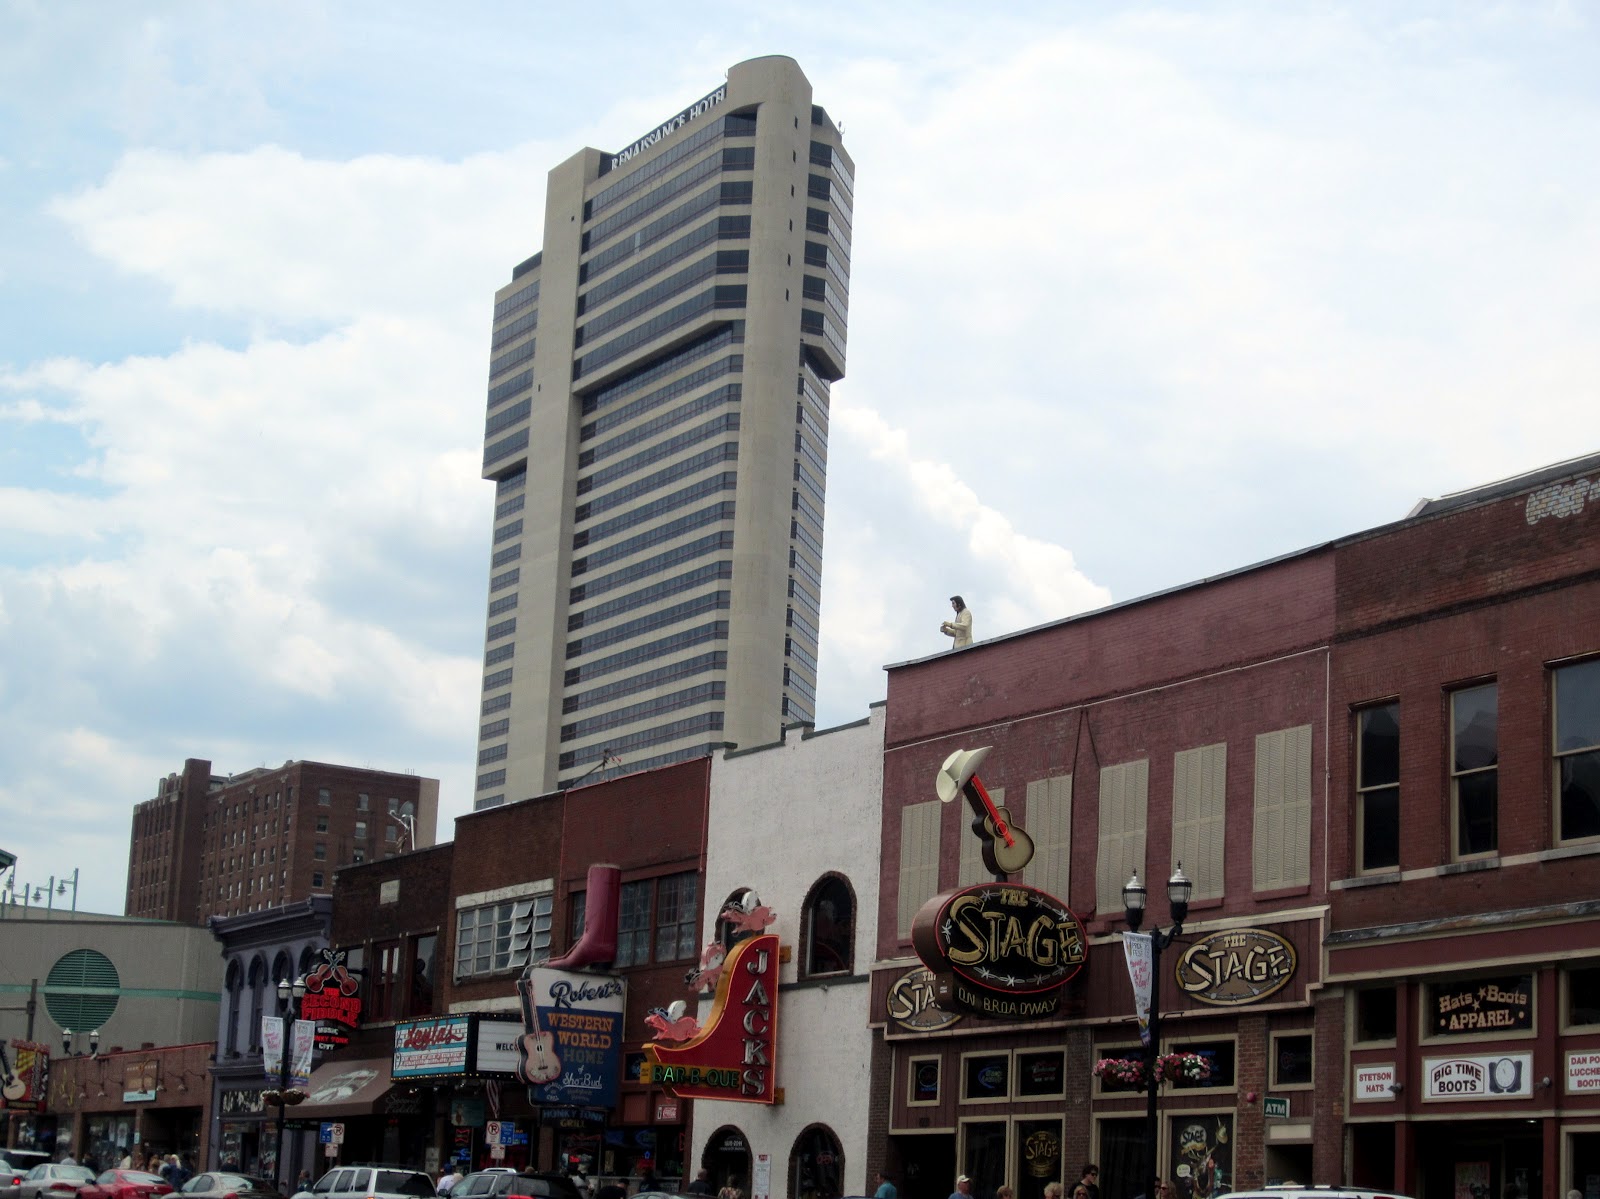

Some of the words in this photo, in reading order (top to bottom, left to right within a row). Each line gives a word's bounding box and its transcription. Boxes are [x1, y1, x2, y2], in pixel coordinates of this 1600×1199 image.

[611, 114, 686, 170] RENAISSANCE
[690, 87, 725, 120] HOTEL
[999, 888, 1029, 907] THE
[949, 895, 1085, 966] STAGE
[1223, 935, 1247, 948] THE
[1183, 944, 1290, 992] STAGE
[301, 993, 362, 1013] SECOND
[550, 980, 622, 1008] Robert's
[892, 978, 941, 1019] STA
[958, 987, 976, 1006] ON
[983, 998, 1058, 1016] BROADWAY
[1439, 991, 1473, 1013] Hats
[1487, 985, 1527, 1005] Boots
[301, 1007, 358, 1028] FIDDLE
[547, 1013, 614, 1032] WESTERN
[742, 948, 769, 1096] JACKS
[1449, 1009, 1514, 1030] APPAREL
[495, 1042, 515, 1051] WELC
[557, 1031, 612, 1049] WORLD
[563, 1048, 604, 1065] HOME
[1571, 1056, 1587, 1065] DAN
[1590, 1056, 1600, 1064] PO
[563, 1072, 602, 1087] Sho-Bud
[652, 1065, 739, 1088] BAR-B-QUE
[1359, 1072, 1391, 1082] STETSON
[1434, 1064, 1453, 1083] BIG
[1455, 1063, 1482, 1081] TIME
[1570, 1067, 1600, 1076] LUCCHE
[1366, 1084, 1384, 1093] HATS
[1438, 1080, 1477, 1093] BOOTS
[1577, 1079, 1600, 1088] BOOT
[1266, 1103, 1285, 1114] ATM
[1182, 1130, 1204, 1144] STAGE
[1026, 1136, 1058, 1159] STAGE
